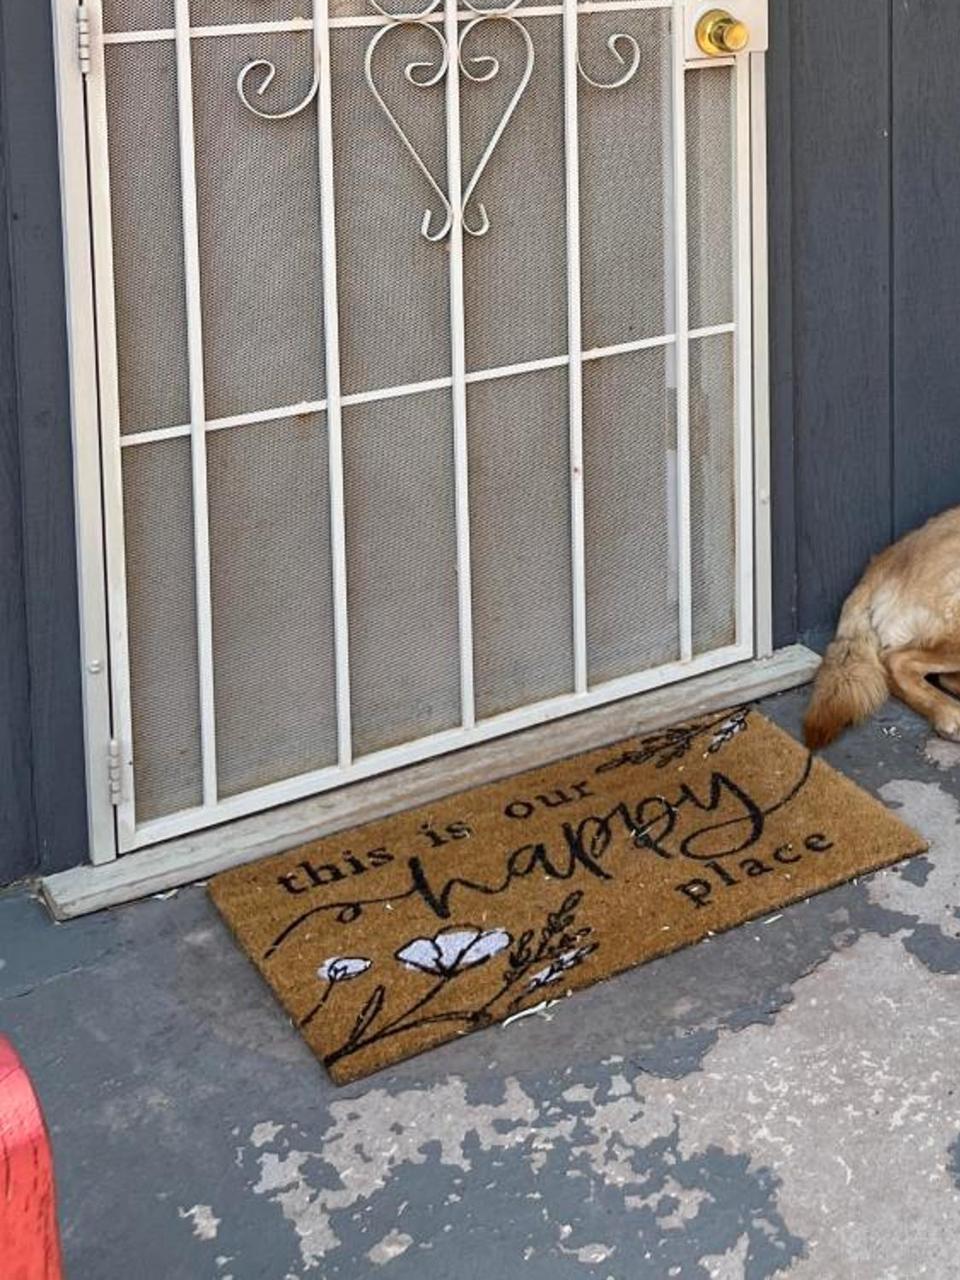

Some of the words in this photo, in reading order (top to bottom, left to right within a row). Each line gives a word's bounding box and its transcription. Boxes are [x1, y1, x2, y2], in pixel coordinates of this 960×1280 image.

[277, 846, 395, 895] this
[418, 821, 473, 848] is
[504, 780, 594, 820] our
[335, 752, 812, 924] happy
[674, 832, 834, 908] place
